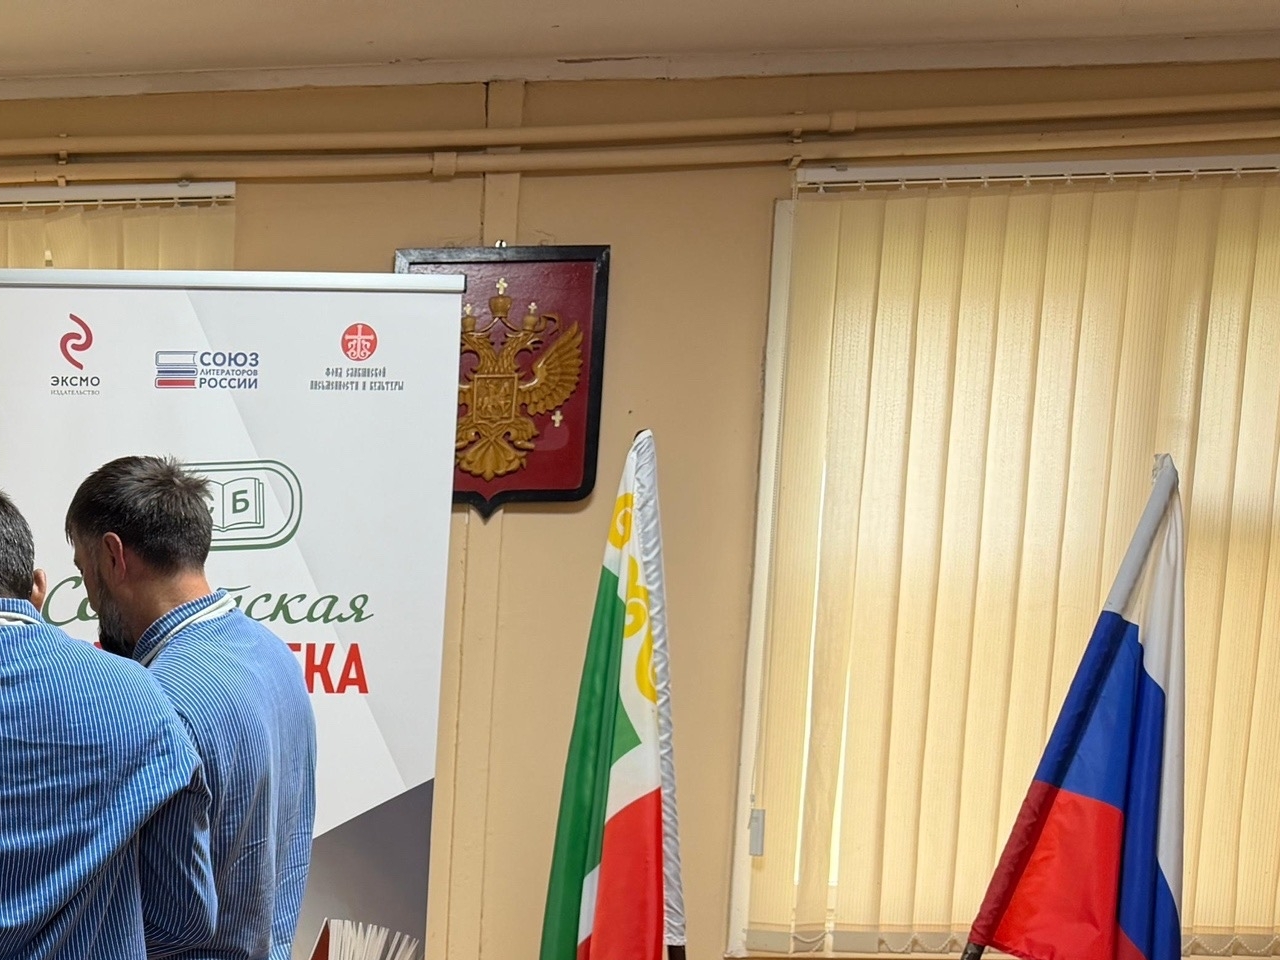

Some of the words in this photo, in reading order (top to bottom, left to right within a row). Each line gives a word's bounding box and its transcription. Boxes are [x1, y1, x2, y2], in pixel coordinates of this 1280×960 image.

[199, 352, 259, 366] СОЮЗ
[51, 376, 100, 386] ЭКСМО
[199, 377, 258, 389] РОССИИ
